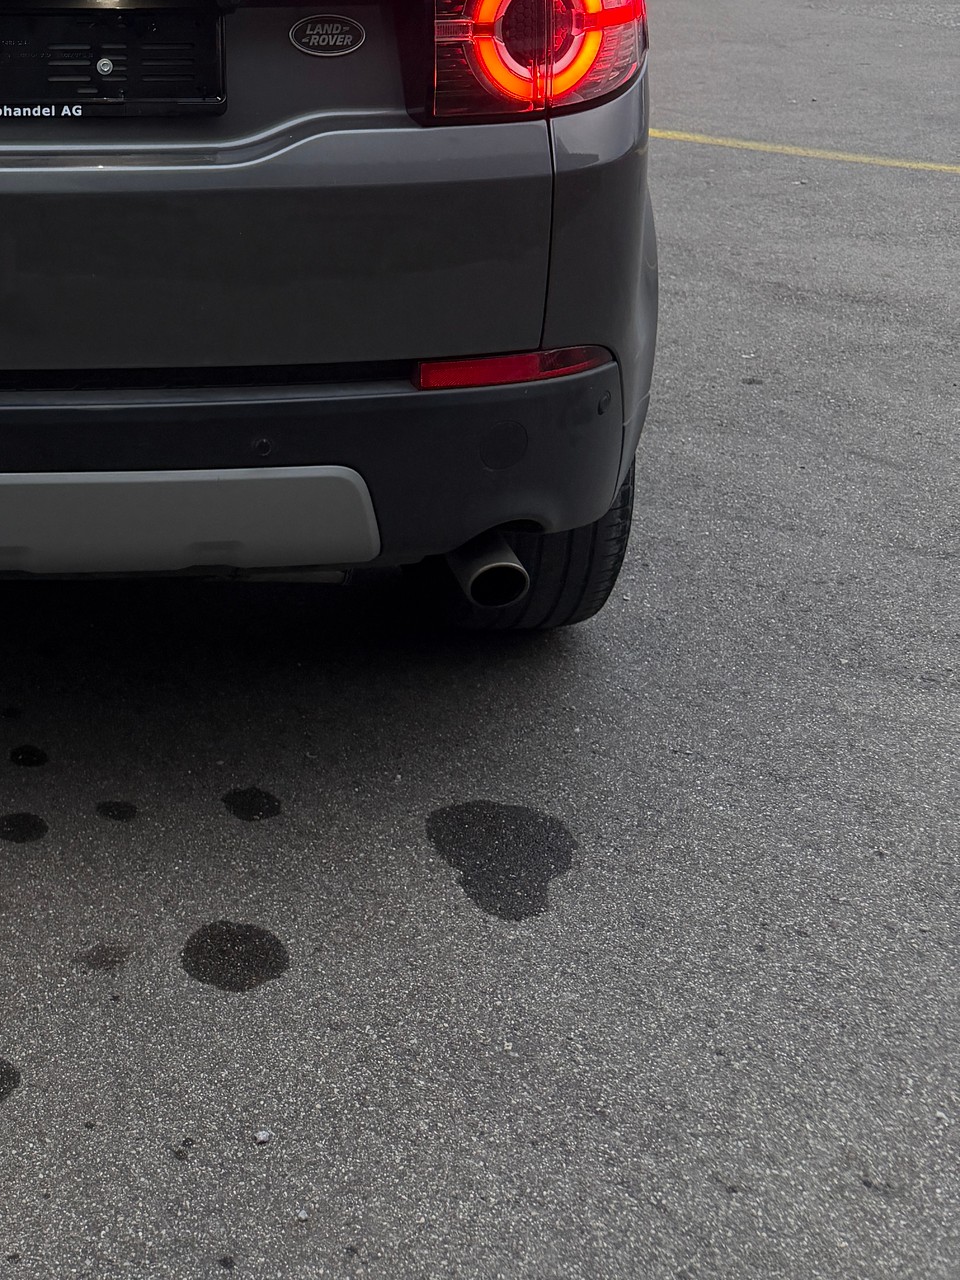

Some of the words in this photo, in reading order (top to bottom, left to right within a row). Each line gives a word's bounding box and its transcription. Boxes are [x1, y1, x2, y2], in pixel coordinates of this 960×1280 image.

[306, 24, 342, 34] LAND
[309, 34, 353, 46] ROVER
[60, 105, 83, 117] AG
